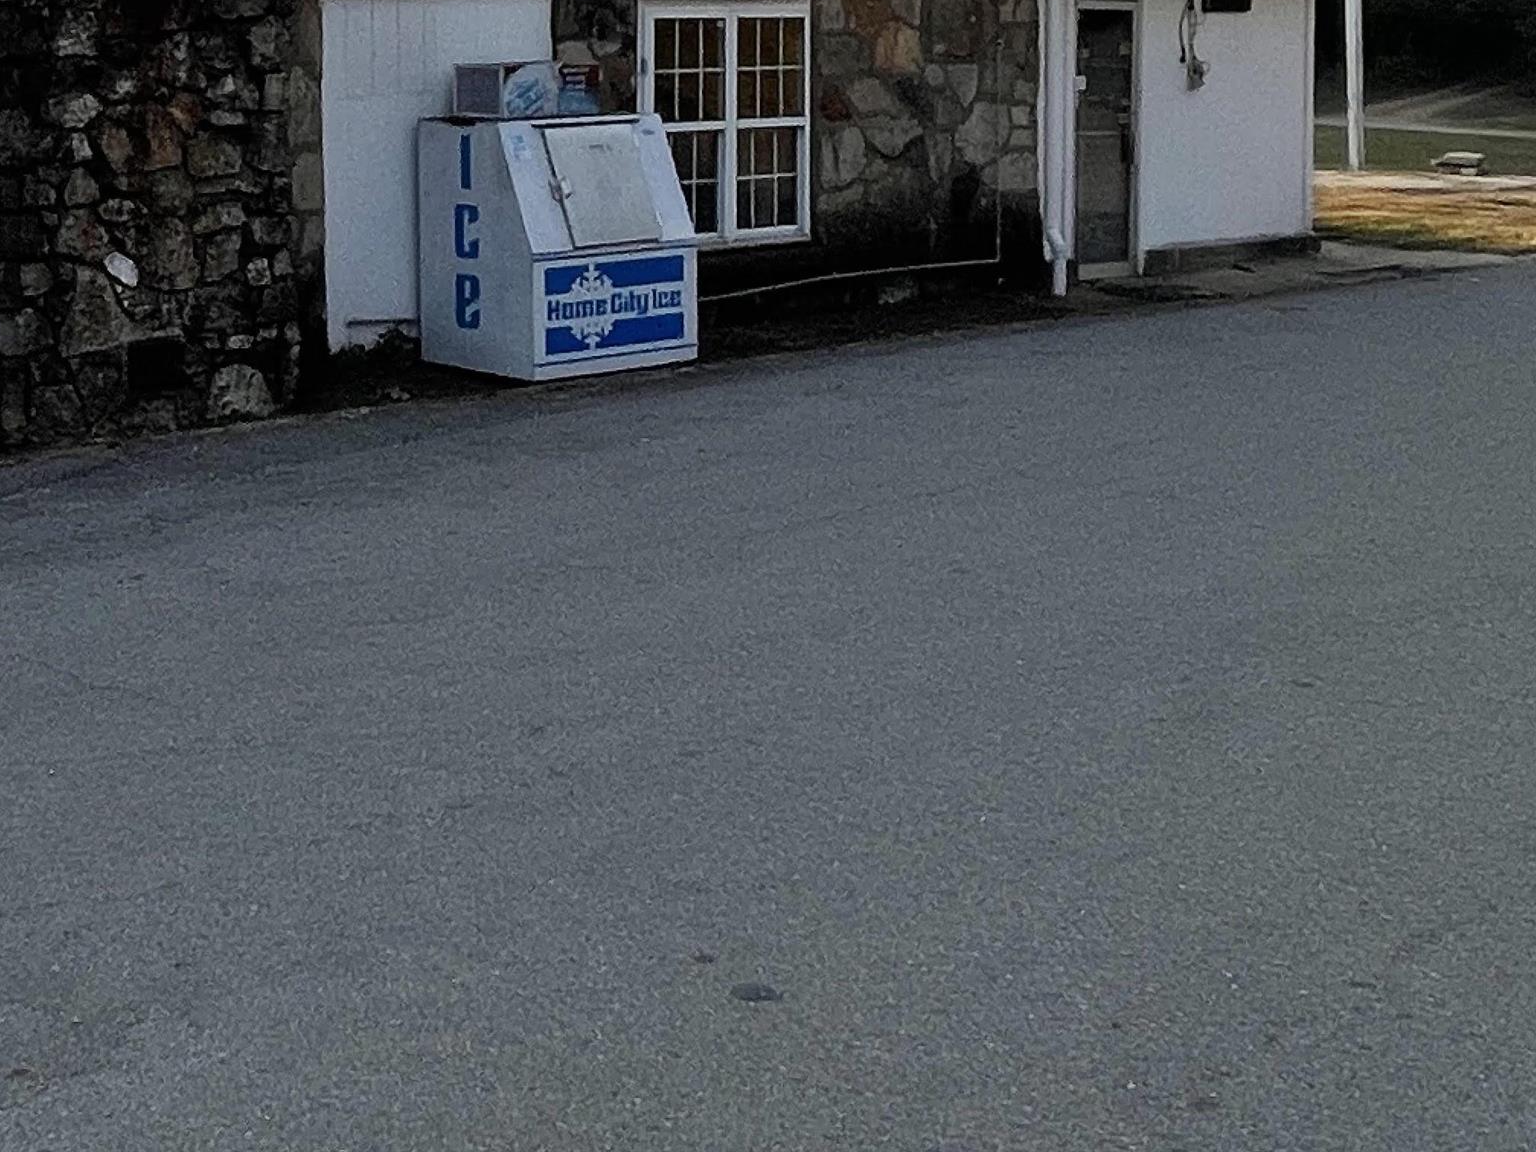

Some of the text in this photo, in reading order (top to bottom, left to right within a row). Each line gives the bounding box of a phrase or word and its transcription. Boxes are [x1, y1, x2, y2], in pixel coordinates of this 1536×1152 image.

[547, 288, 682, 321] Home City Ice
